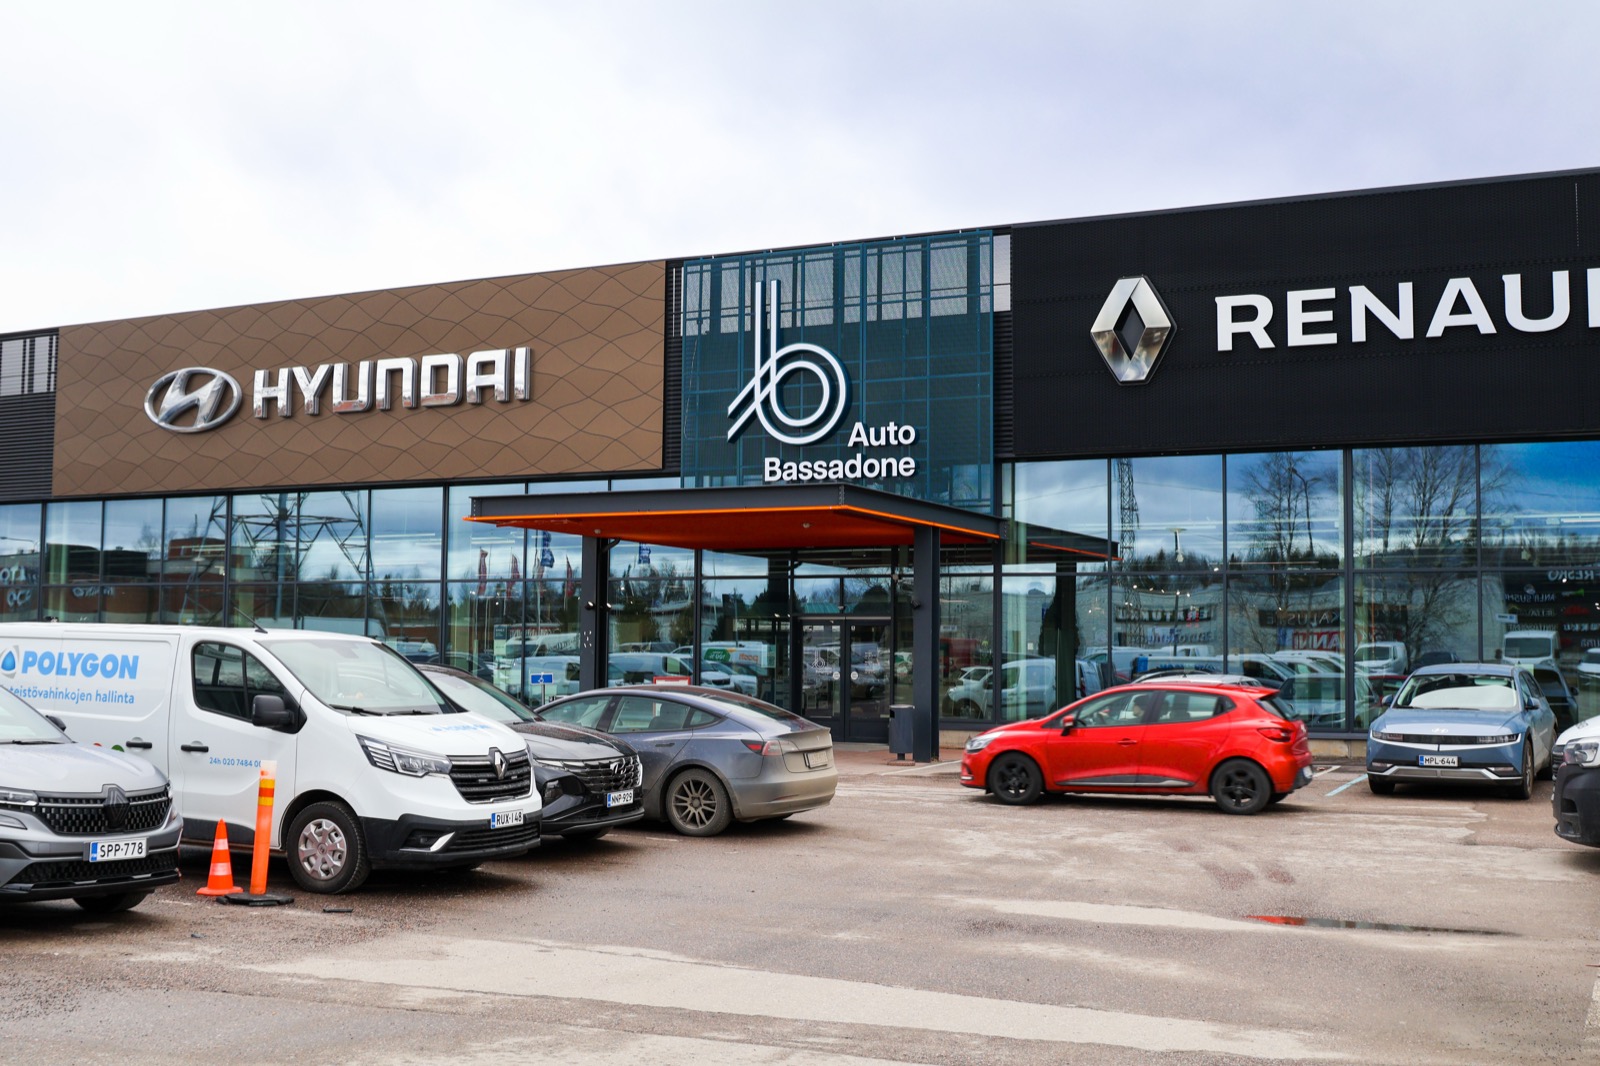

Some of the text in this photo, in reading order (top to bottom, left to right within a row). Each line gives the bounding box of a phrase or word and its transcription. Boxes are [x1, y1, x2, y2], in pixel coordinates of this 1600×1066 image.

[1214, 267, 1600, 351] RENAU
[253, 346, 532, 419] HYUNDAI
[848, 421, 916, 448] Auto
[764, 453, 916, 482] Bassadone
[21, 650, 140, 680] POLYGON
[9, 685, 135, 705] teistövahinkojen hallinta
[209, 757, 221, 765] 24h
[222, 757, 235, 766] 020
[236, 758, 253, 767] 7484
[1424, 757, 1456, 765] MPL-644
[611, 792, 633, 804] NNP-929
[496, 811, 522, 826] RUX-148
[100, 841, 144, 858] SPP-778
